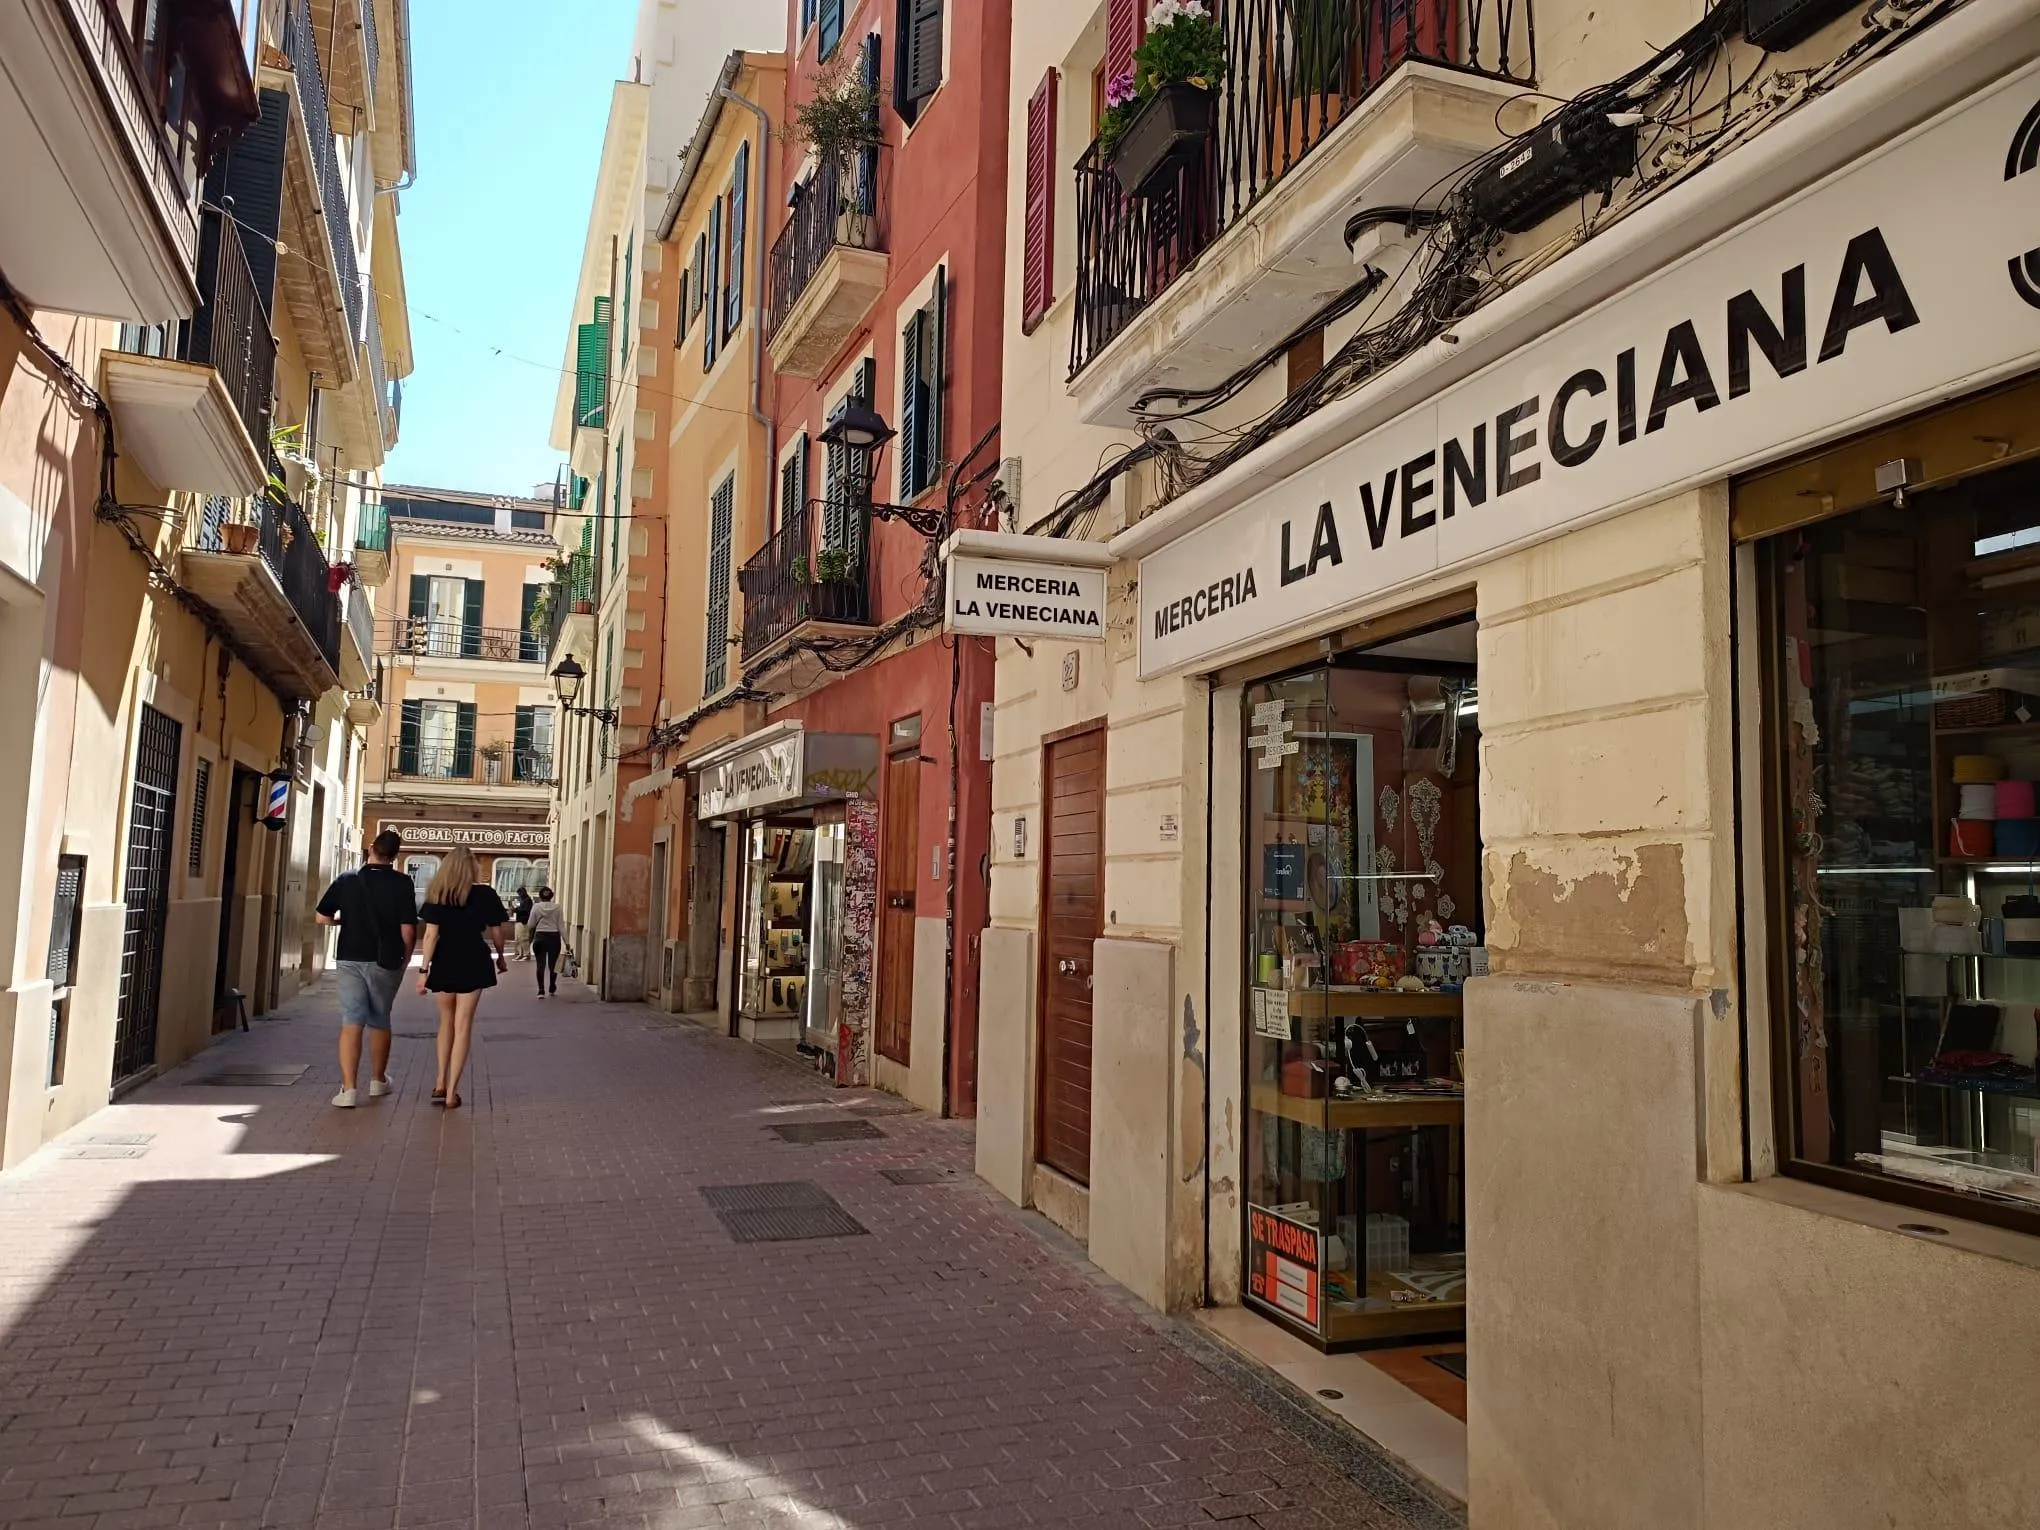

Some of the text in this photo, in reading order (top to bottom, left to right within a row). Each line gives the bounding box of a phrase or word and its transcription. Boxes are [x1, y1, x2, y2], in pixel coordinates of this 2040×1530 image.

[1154, 226, 1920, 640] MERCERIA LA VENECIANA
[976, 573, 1080, 597] MERCERIA
[955, 599, 1099, 626] LA VENECIANA
[1064, 662, 1074, 682] 22
[403, 828, 551, 844] GLOBAL TATTOO FACTOR
[1252, 1211, 1317, 1264] SE TRASPASA
